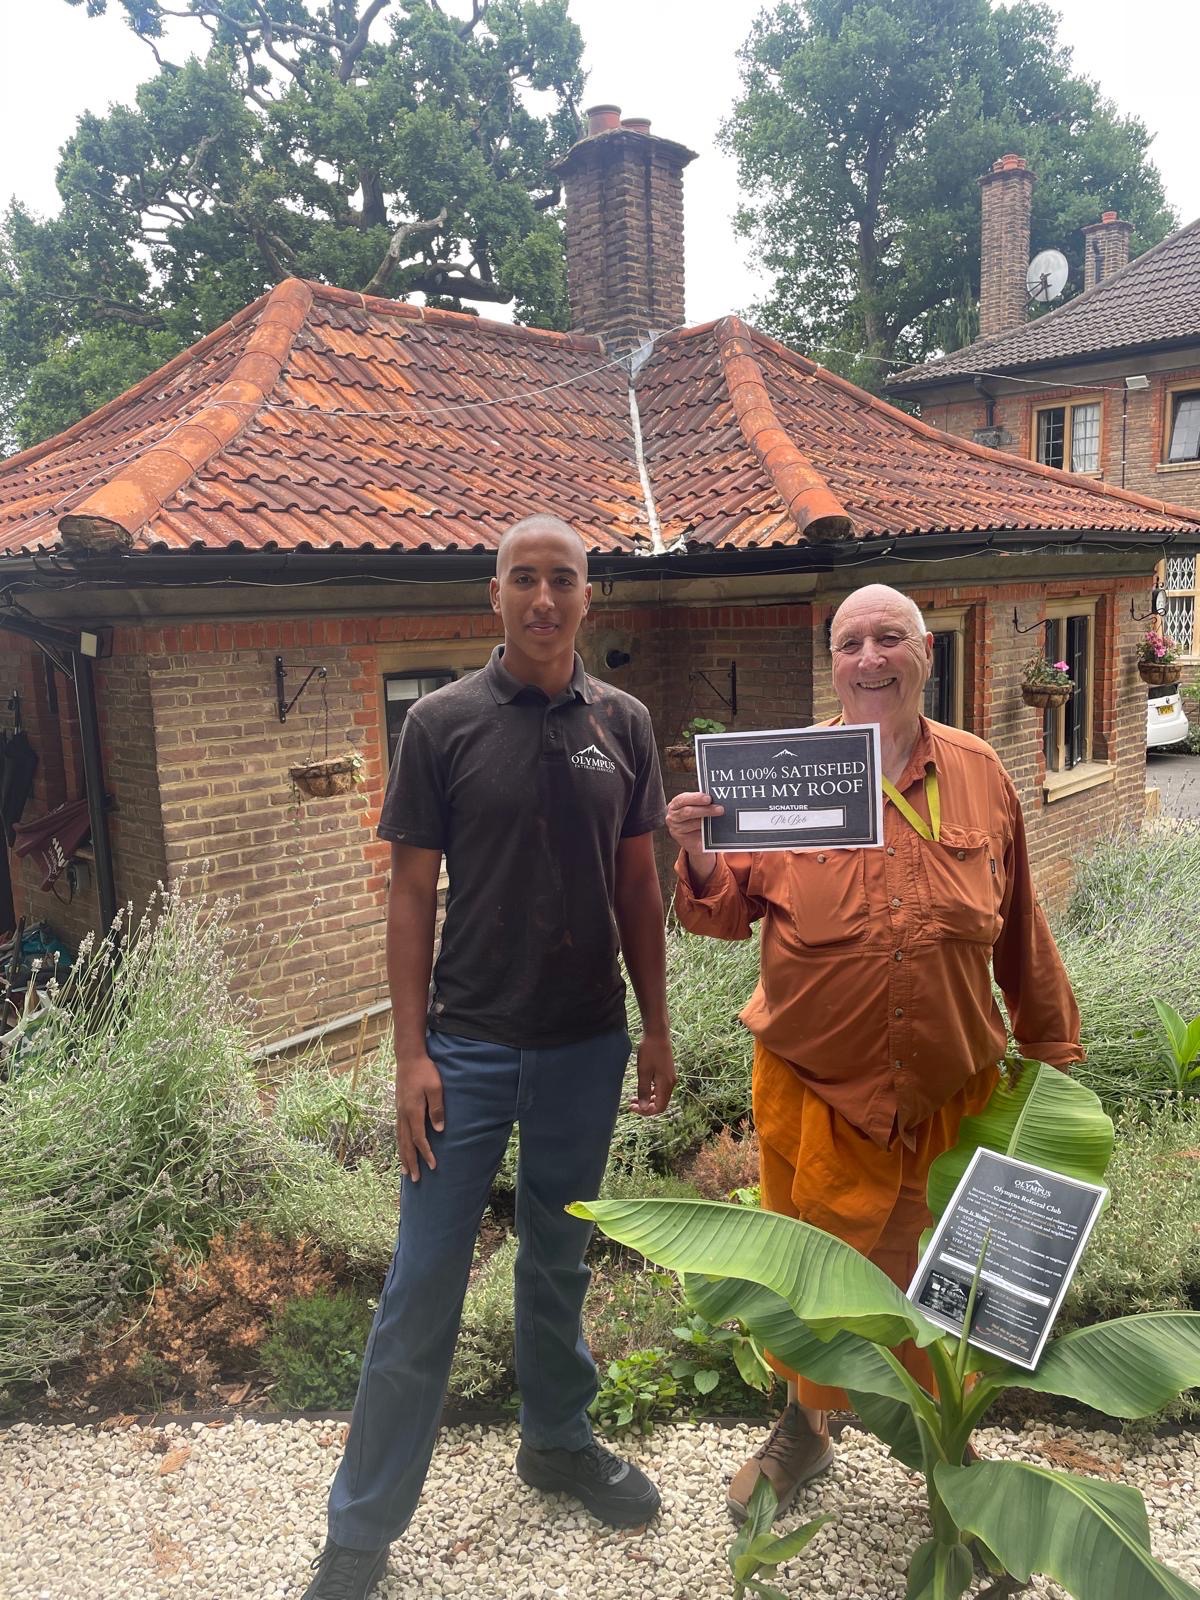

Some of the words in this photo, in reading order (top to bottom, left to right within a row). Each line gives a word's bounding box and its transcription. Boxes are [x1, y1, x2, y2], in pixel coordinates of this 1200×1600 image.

[572, 756, 616, 770] OLYMPUS
[710, 769, 734, 782] I'M
[739, 766, 778, 780] 100%
[781, 761, 866, 779] SATISFIED
[712, 784, 766, 800] WITH
[772, 783, 802, 798] MY
[808, 779, 864, 796] ROOF
[1014, 1180, 1052, 1197] OLYMPUS
[993, 1185, 1020, 1200] Olympus
[1021, 1195, 1046, 1210] Referral
[1046, 1204, 1062, 1214] Club
